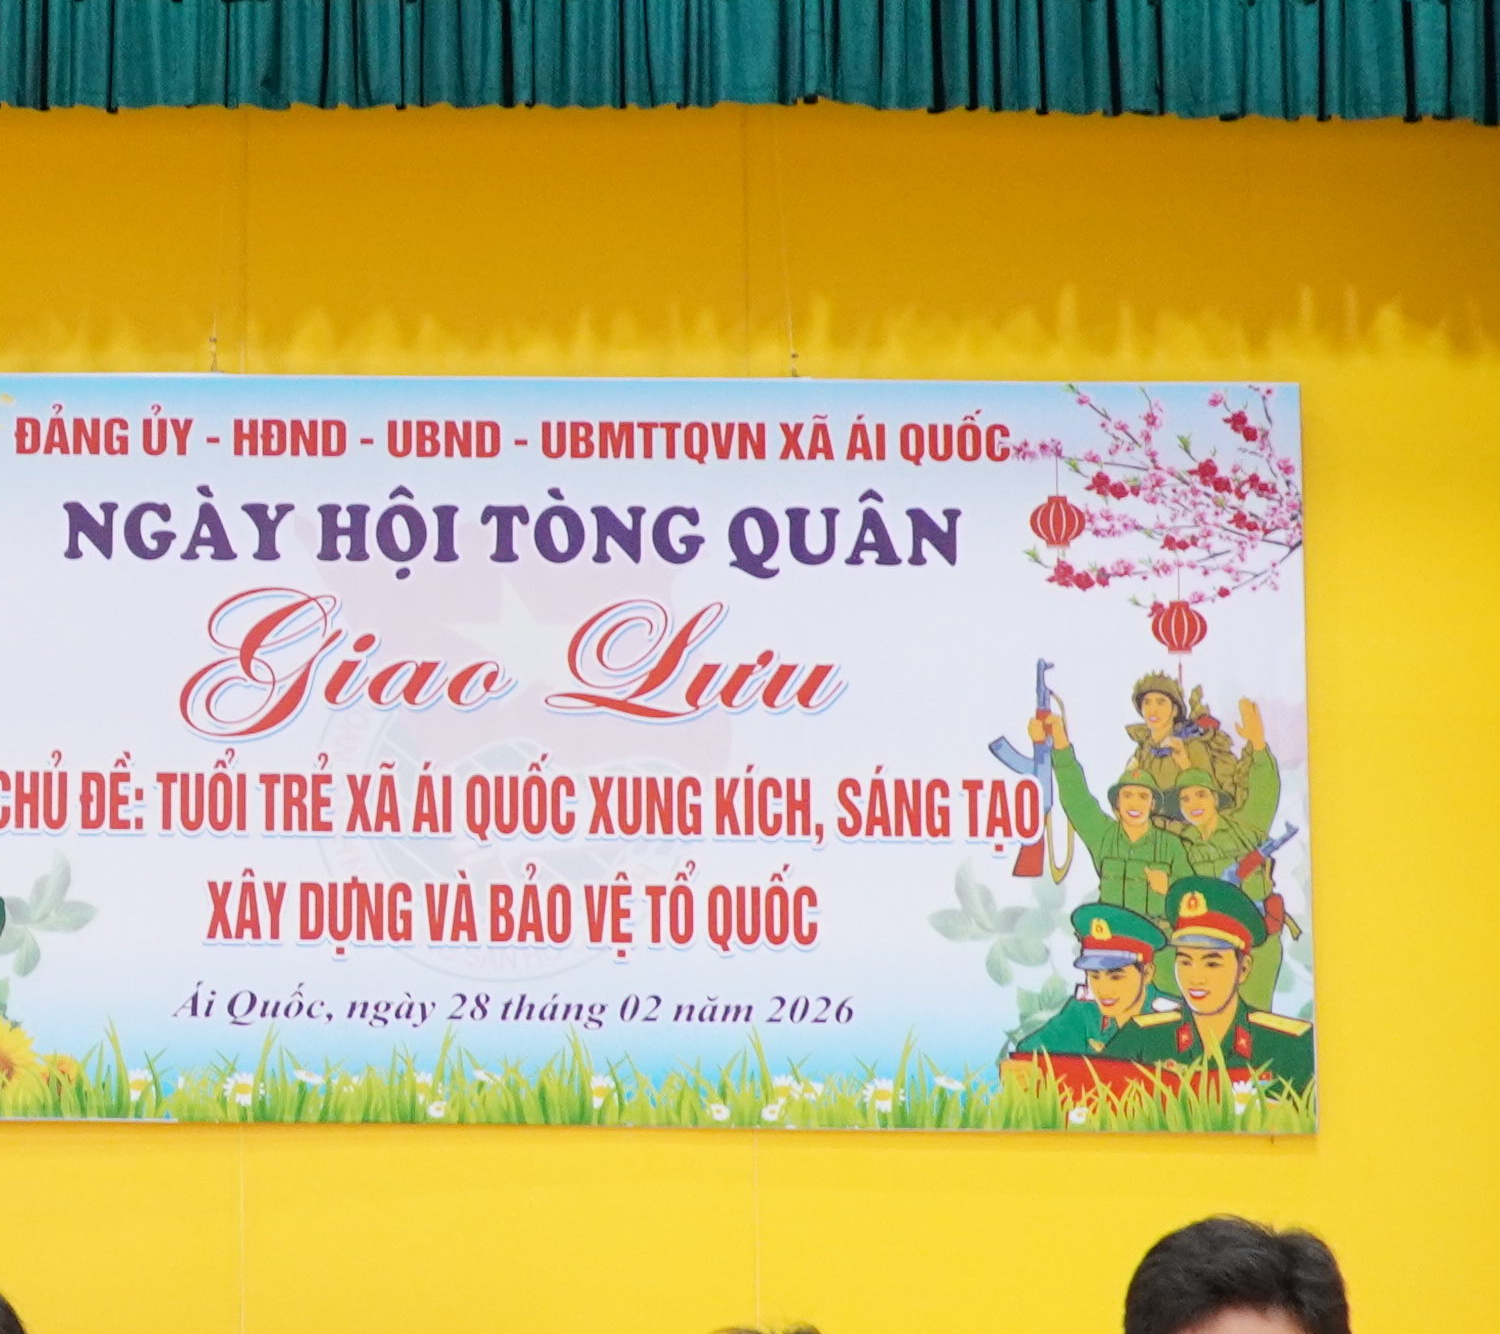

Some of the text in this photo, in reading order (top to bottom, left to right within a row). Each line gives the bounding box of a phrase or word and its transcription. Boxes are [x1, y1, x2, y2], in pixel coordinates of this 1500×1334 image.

[14, 404, 129, 456] ĐẢNG
[142, 404, 193, 456] ỦY
[233, 419, 347, 457] HĐND
[387, 420, 501, 459] UBND
[541, 421, 767, 465] UBMTTQVN
[779, 414, 835, 461] XÃ
[846, 414, 887, 461] ÁI
[899, 409, 1011, 466] QUỐC
[62, 485, 962, 580] NGÀY HỘI TÒNG QUÂN
[179, 587, 846, 737] Giao Lưu
[79, 747, 145, 830] ĐỀ:
[156, 747, 247, 832] TUỔI
[258, 752, 334, 832] TRẺ
[346, 761, 401, 833] XÃ
[412, 761, 453, 833] ÁI
[465, 754, 576, 841] QUỐC
[589, 775, 703, 836] XUNG
[715, 763, 826, 845] KÍCH,
[837, 764, 951, 838] SÁNG
[962, 778, 1041, 853] TẠO
[207, 860, 819, 958] XÂY DỰNG VÀ BẢO VỆ TỔ QUỐC
[172, 980, 855, 1029] Ái Quốc, ngày 28 tháng 02 năm 2026
